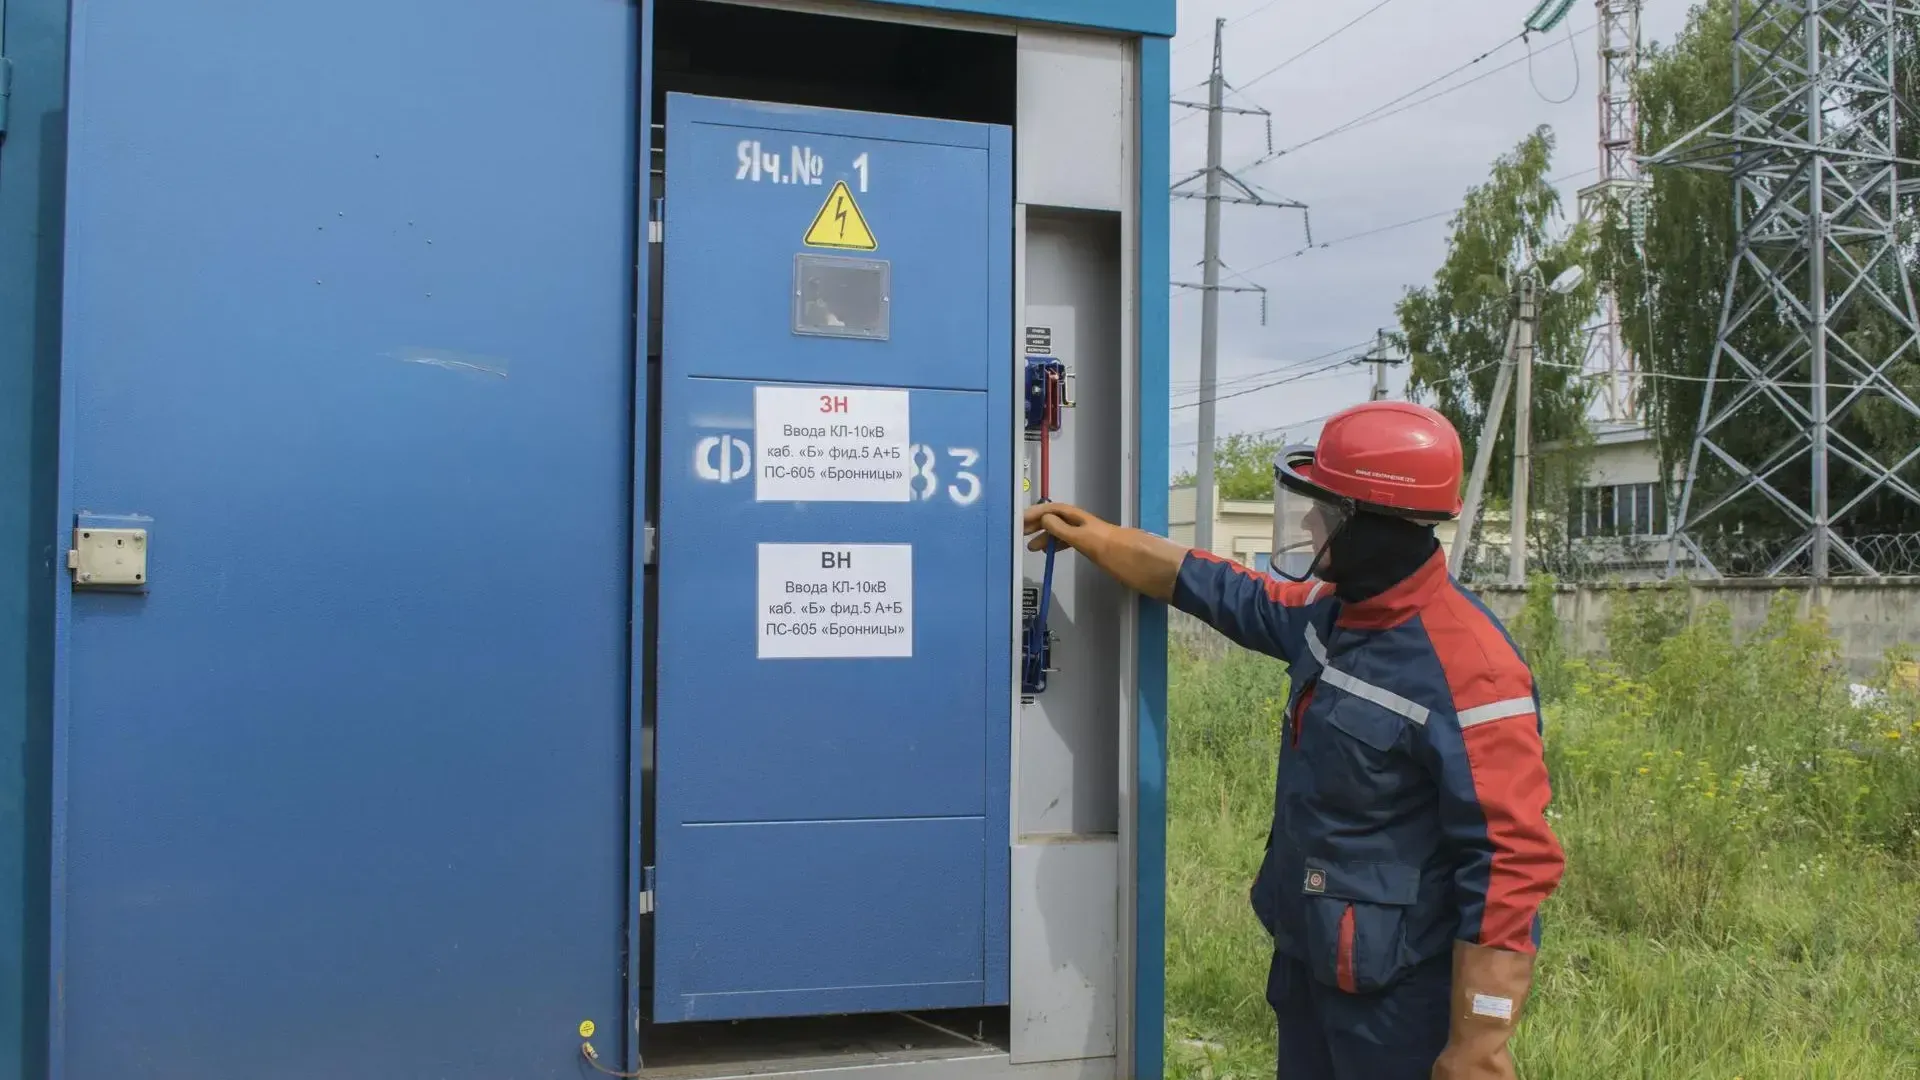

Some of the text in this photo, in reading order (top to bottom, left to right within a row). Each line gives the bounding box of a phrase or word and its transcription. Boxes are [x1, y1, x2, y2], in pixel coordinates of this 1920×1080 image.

[852, 151, 869, 193] 1
[819, 395, 848, 413] ЗН
[783, 424, 885, 439] Ввода КЛ-10кВ
[695, 434, 751, 484] Ф
[767, 445, 901, 461] каб. «Б» фид.5 А+Б
[764, 465, 903, 482] ПС-605 «Бронницы»
[821, 551, 852, 569] ВН
[785, 581, 887, 595] Ввода КЛ-10кВ
[769, 601, 903, 617] каб. «Б» фид.5 А+Б
[766, 622, 905, 638] ПС-605 «Бронницы»
